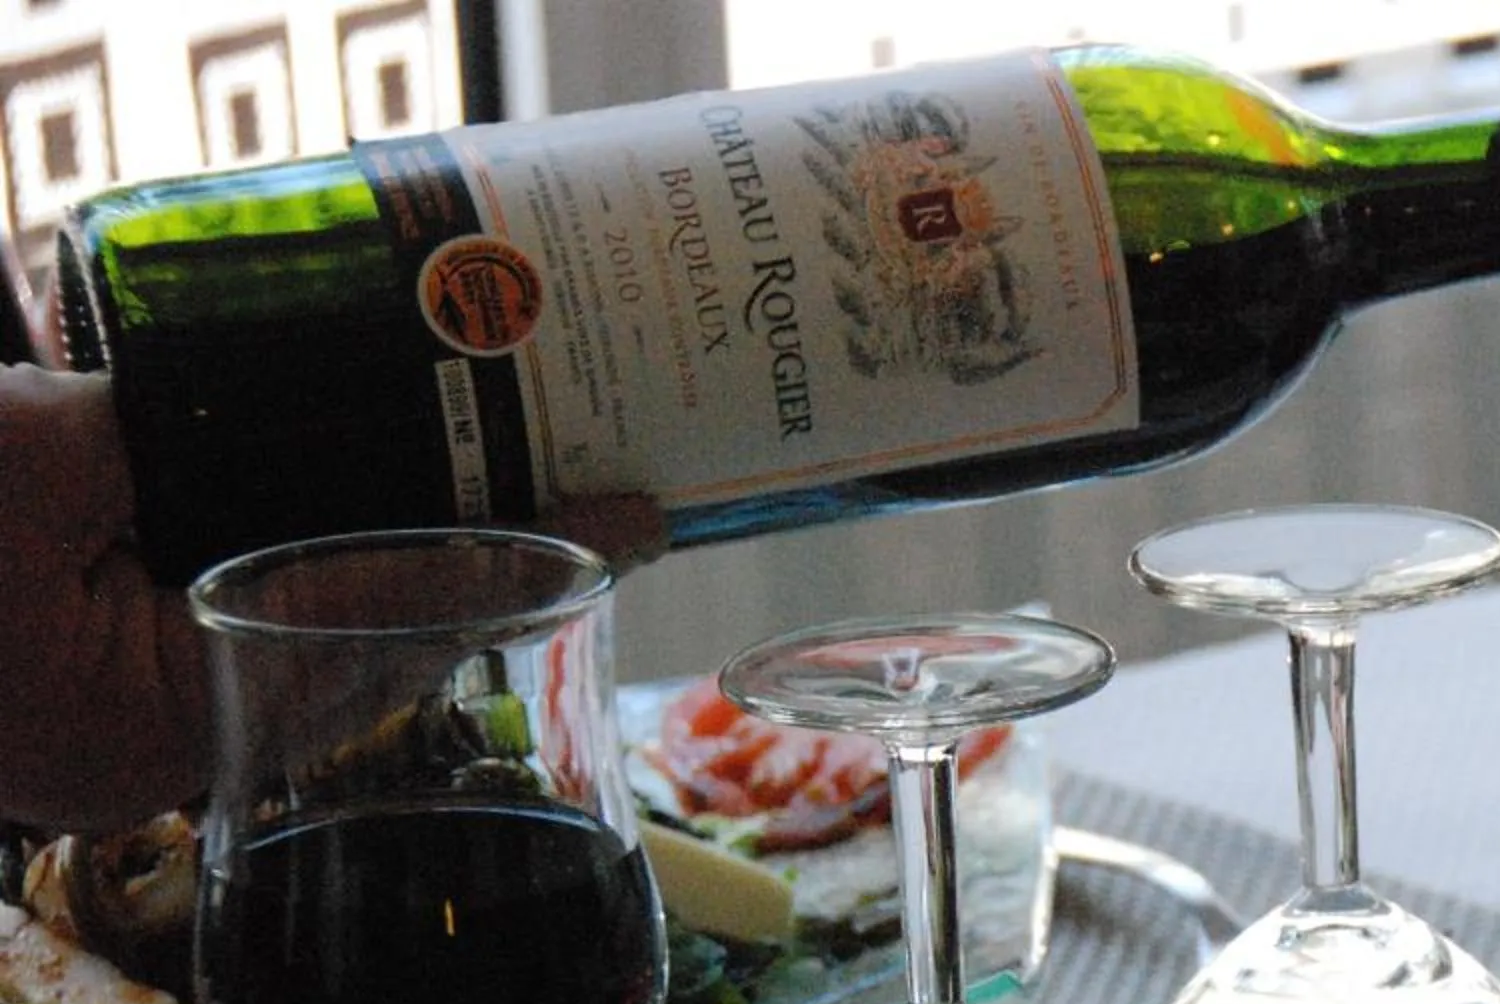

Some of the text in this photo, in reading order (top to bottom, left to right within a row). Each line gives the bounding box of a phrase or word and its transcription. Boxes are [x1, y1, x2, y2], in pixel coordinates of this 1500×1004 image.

[604, 227, 642, 304] 2010
[658, 166, 730, 353] BORDEAUX
[744, 256, 813, 442] ROUGIER
